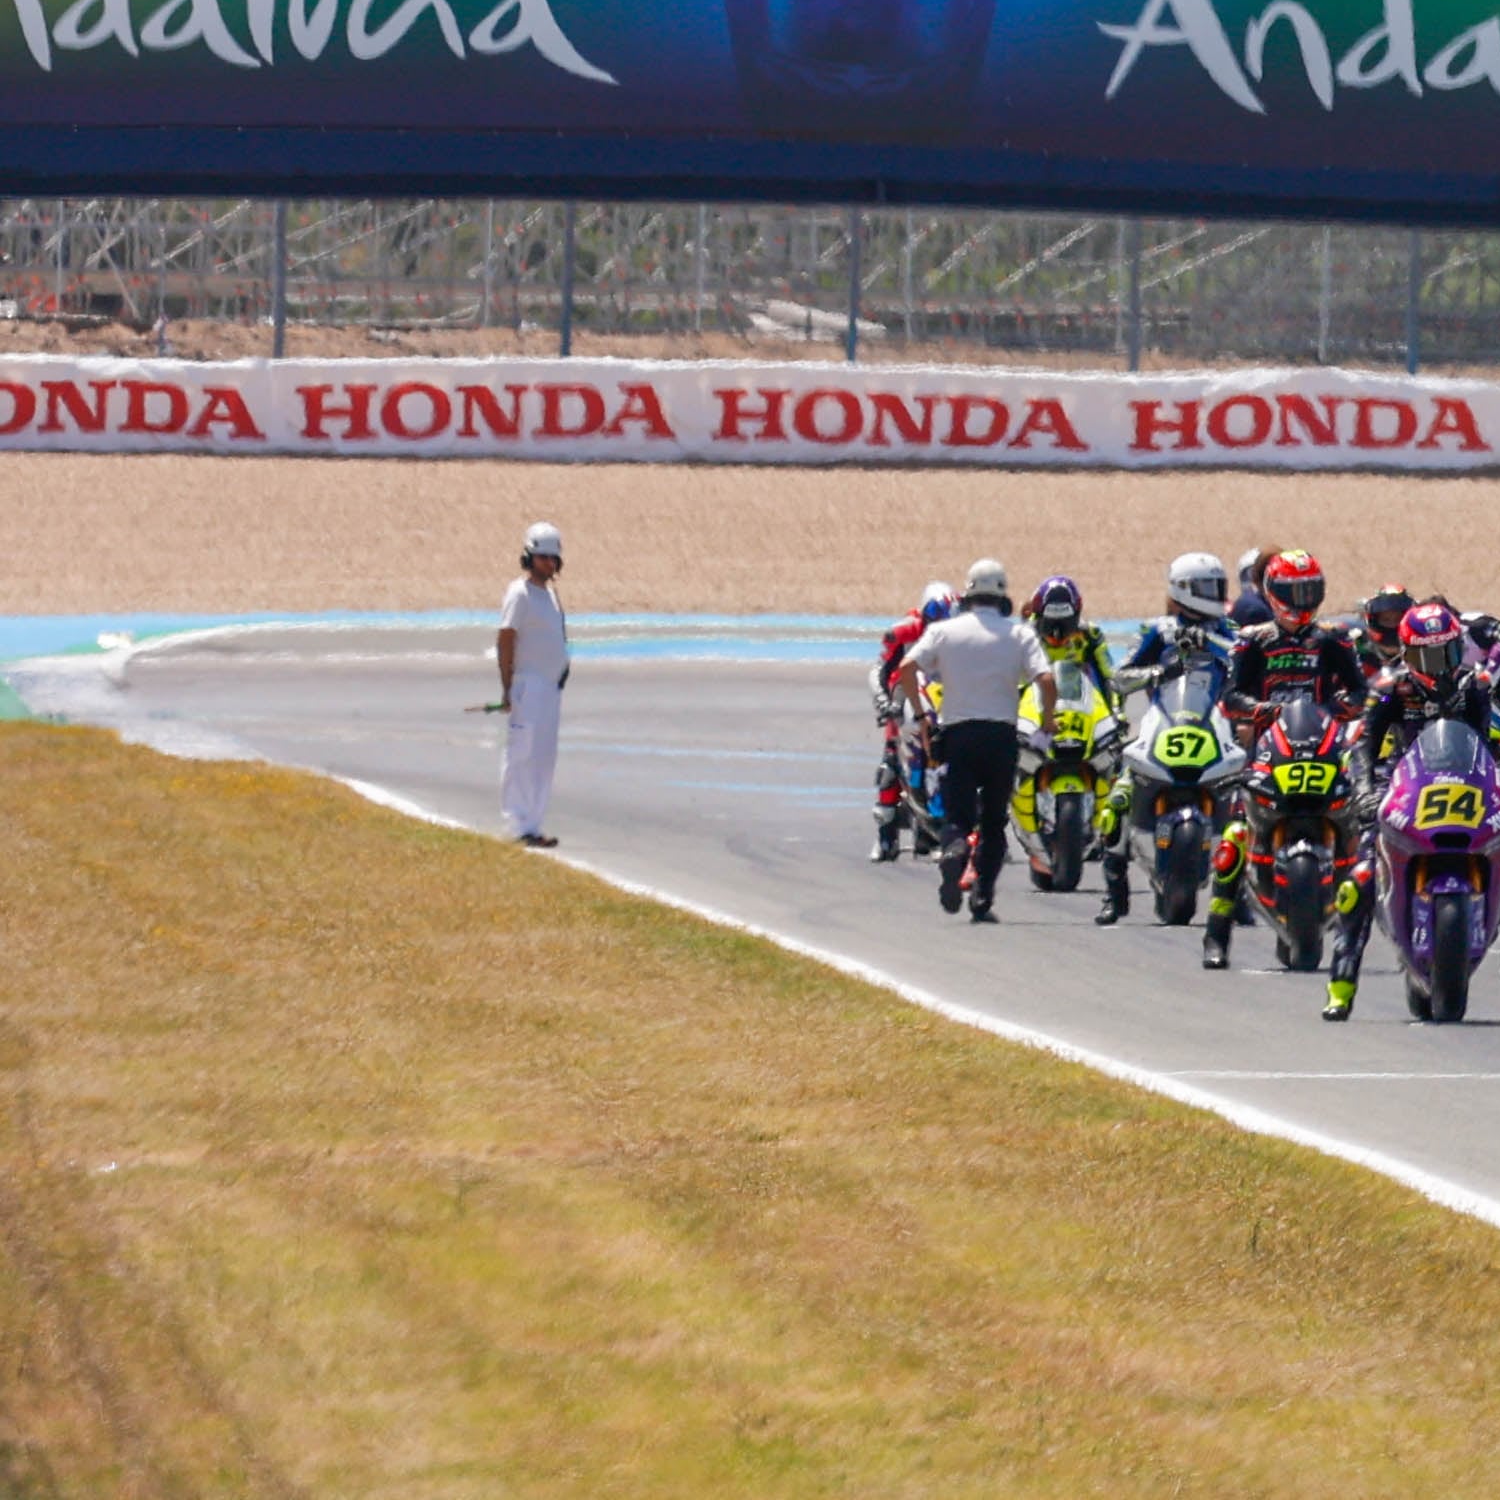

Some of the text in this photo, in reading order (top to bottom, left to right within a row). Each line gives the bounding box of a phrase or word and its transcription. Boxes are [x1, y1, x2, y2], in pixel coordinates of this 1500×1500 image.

[296, 381, 676, 441] HONDA
[713, 387, 1089, 450] HONDA
[1129, 393, 1492, 452] HONDA
[1166, 732, 1205, 758] 57
[1288, 764, 1326, 793] 92
[1424, 788, 1478, 822] 54
